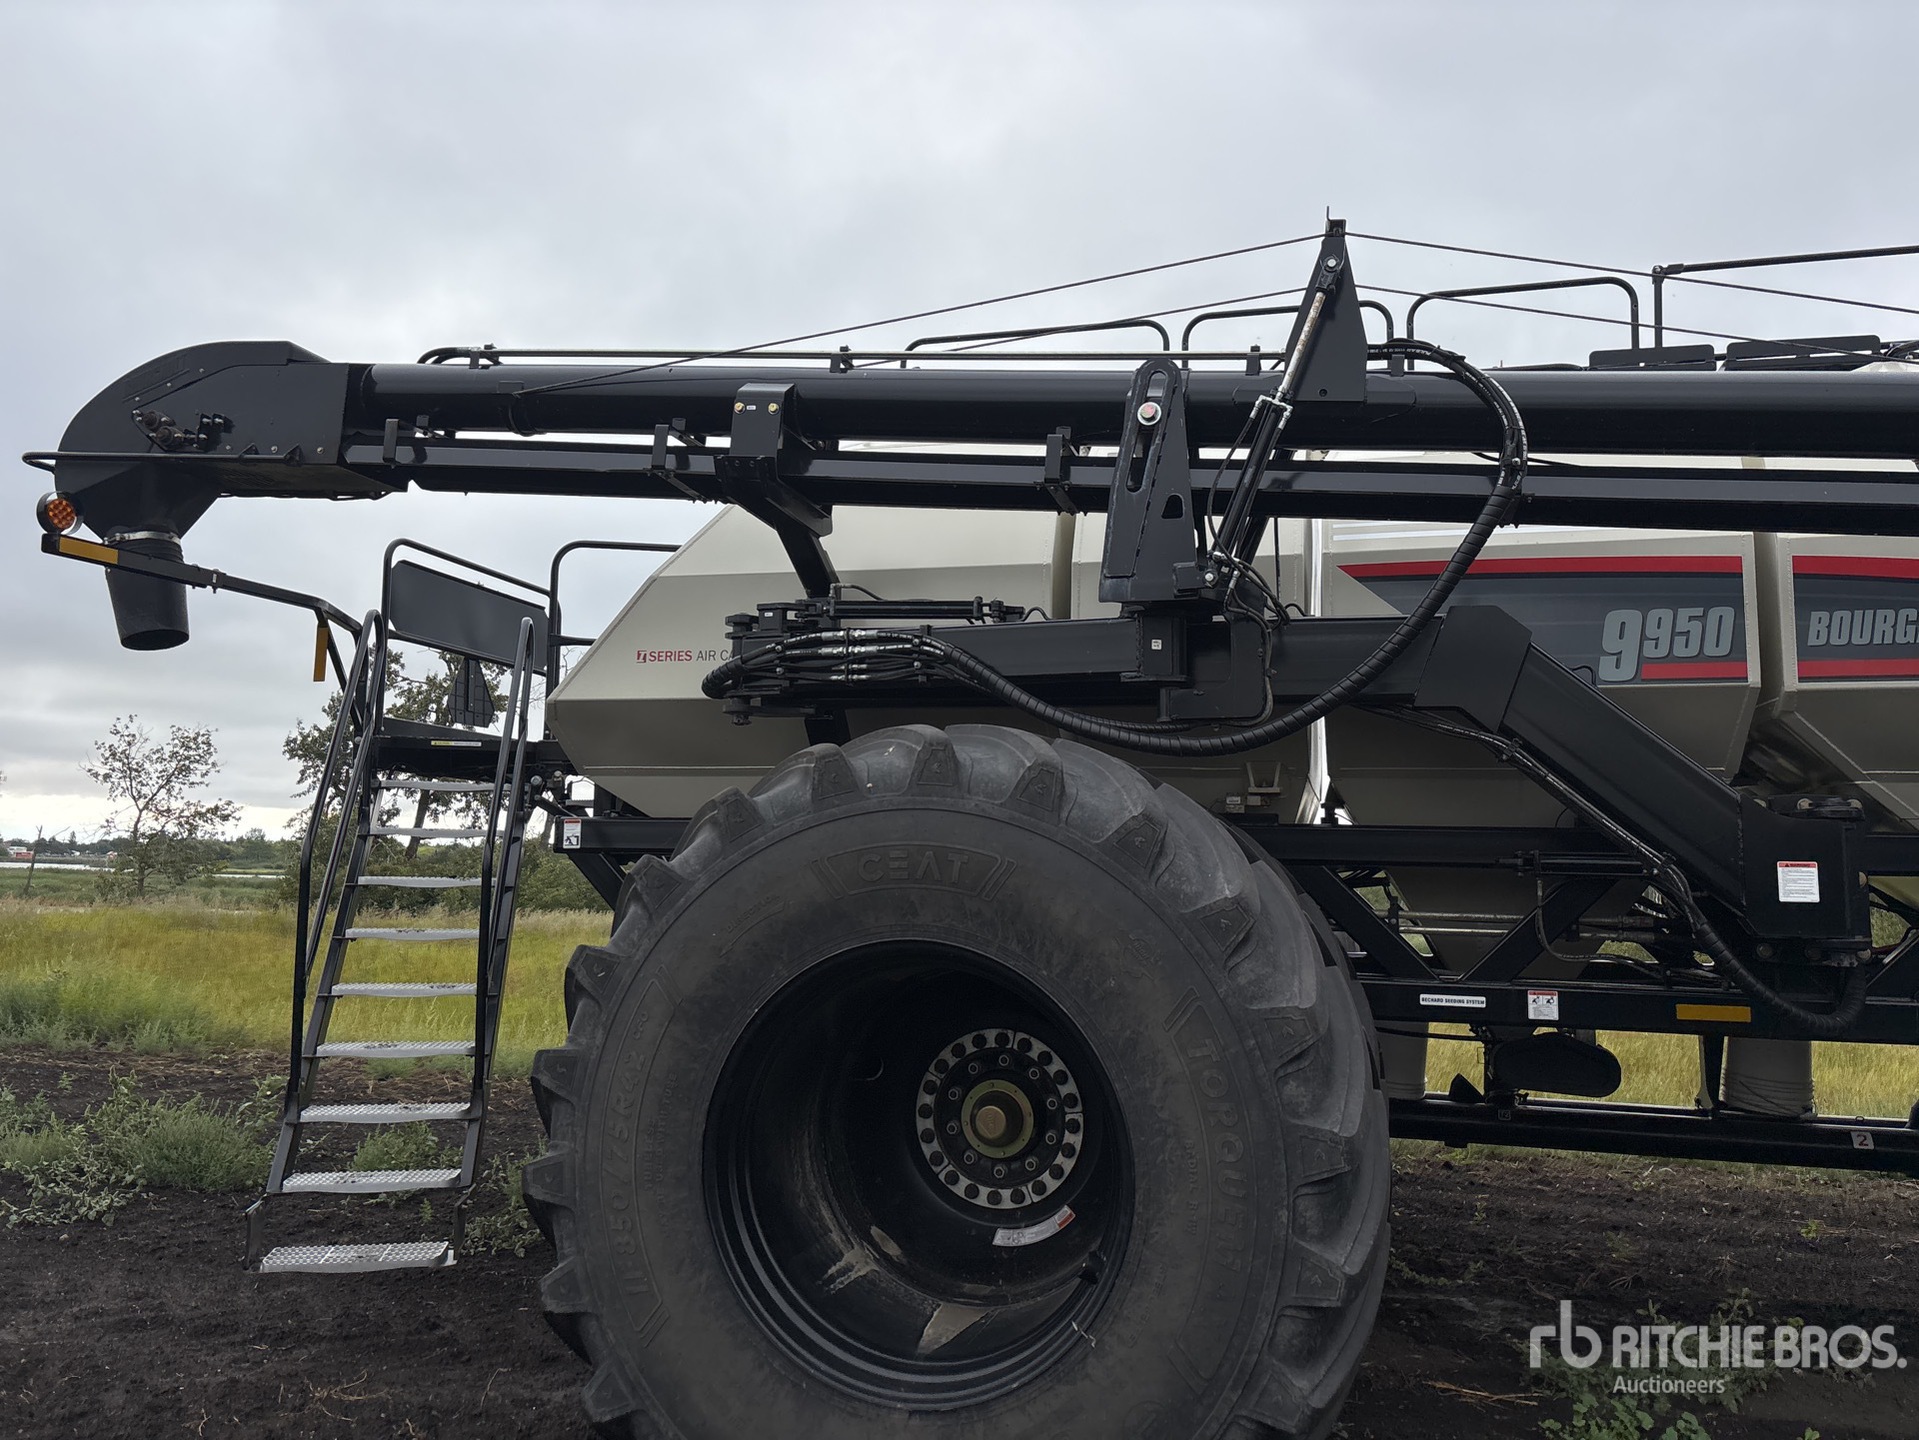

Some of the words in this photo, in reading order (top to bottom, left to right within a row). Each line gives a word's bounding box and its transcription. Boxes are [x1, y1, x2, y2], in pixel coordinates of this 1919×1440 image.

[1598, 606, 1735, 682] 9950
[1807, 607, 1919, 646] BOURG
[648, 650, 693, 662] SERIES
[696, 650, 717, 661] AIR
[858, 849, 969, 884] CEAT
[1856, 1133, 1869, 1147] 2
